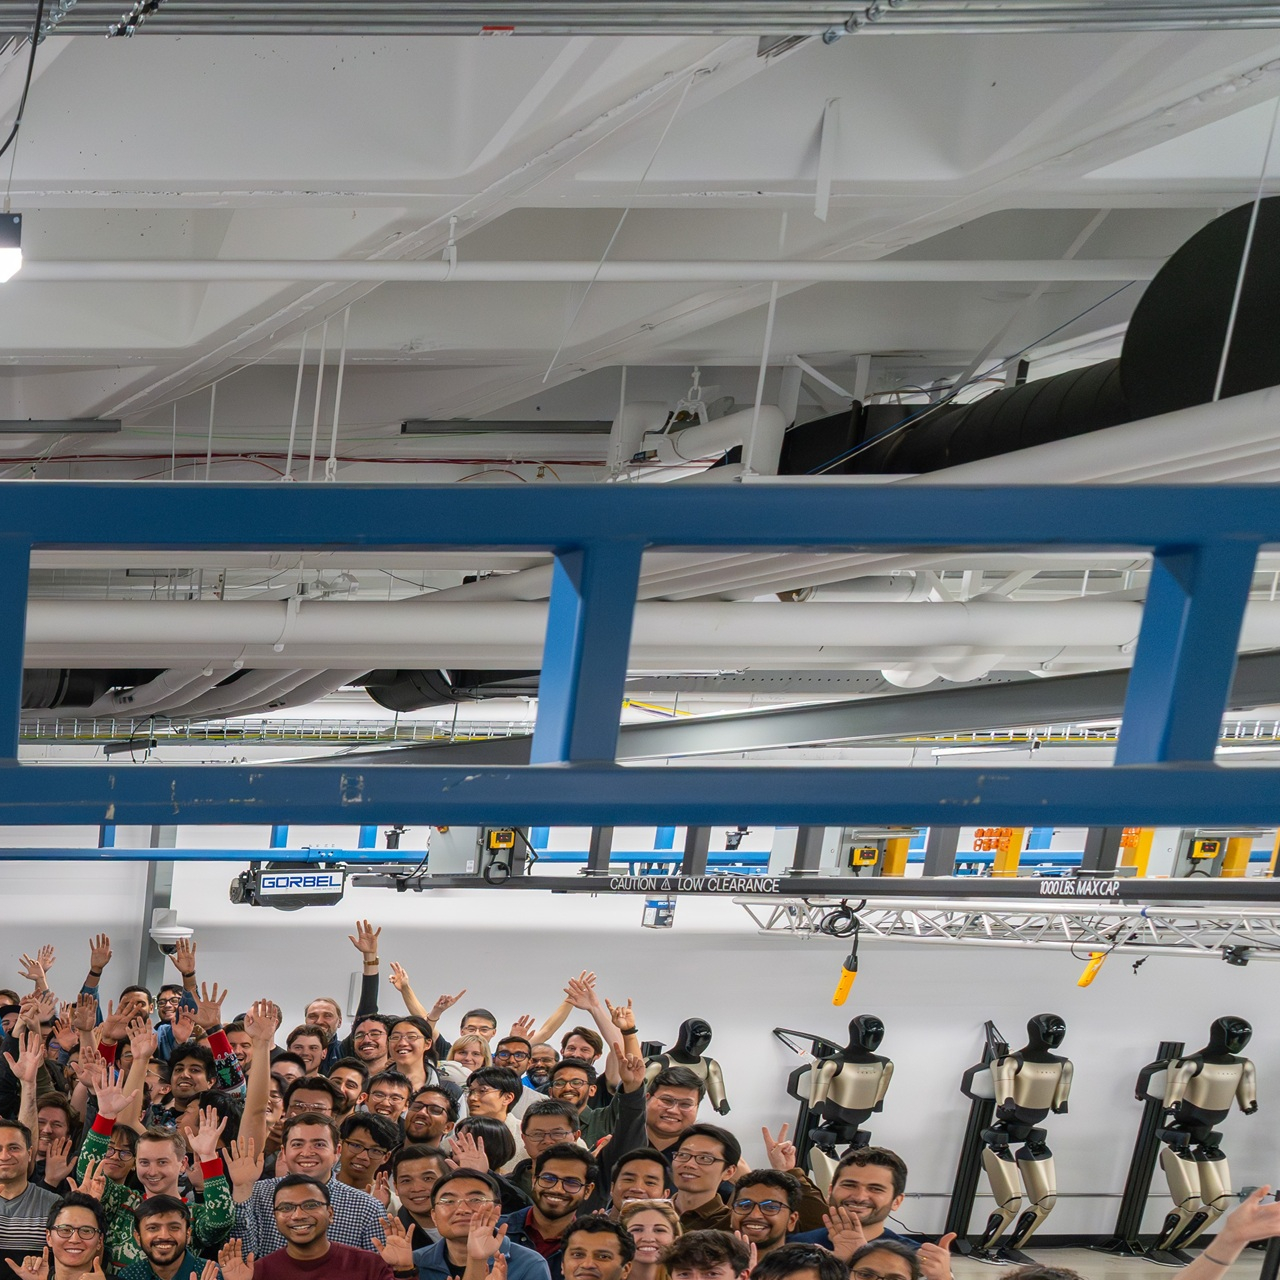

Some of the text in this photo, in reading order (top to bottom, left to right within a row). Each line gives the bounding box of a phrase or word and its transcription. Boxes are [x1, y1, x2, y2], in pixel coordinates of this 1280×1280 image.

[261, 875, 342, 889] GORBEL
[610, 878, 780, 893] CAUTION LOW CLEARANCE
[1040, 881, 1121, 897] 1000 LBS. MAX CAP.
